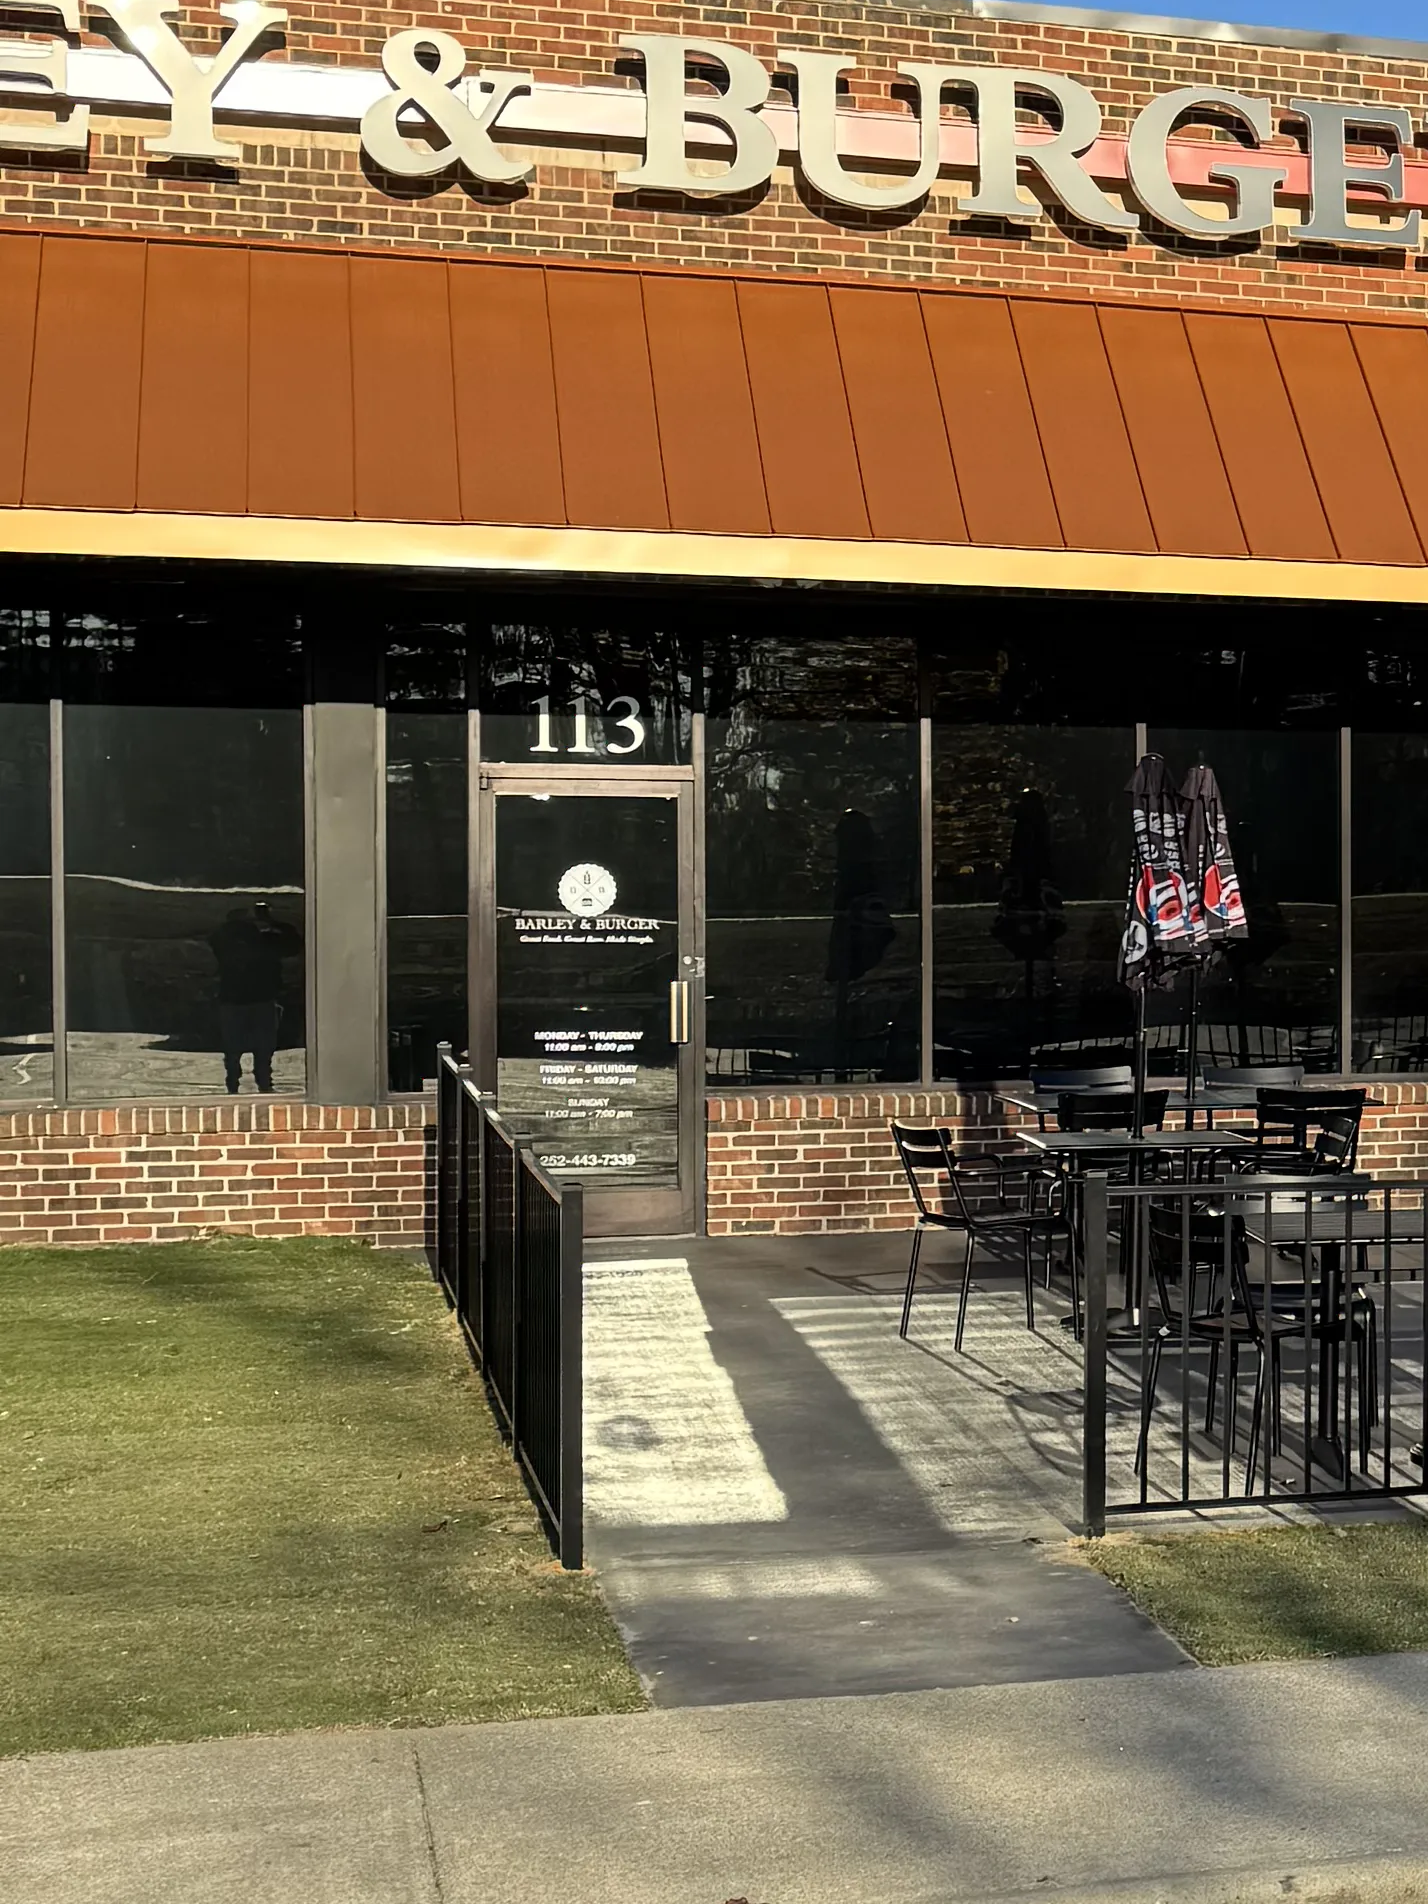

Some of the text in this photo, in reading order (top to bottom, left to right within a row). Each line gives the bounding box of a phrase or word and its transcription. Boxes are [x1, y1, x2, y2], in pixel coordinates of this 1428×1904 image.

[360, 28, 534, 185] &
[529, 695, 645, 754] 113
[515, 918, 660, 930] BARLEY & BURGER
[534, 1031, 580, 1040] MONDAY
[588, 1031, 643, 1040] THURSDAY
[540, 1065, 577, 1074] FRIDAY
[584, 1064, 639, 1074] SATURDAY
[568, 1098, 610, 1107] SUNDAY
[540, 1154, 636, 1167] 252-443-7339
